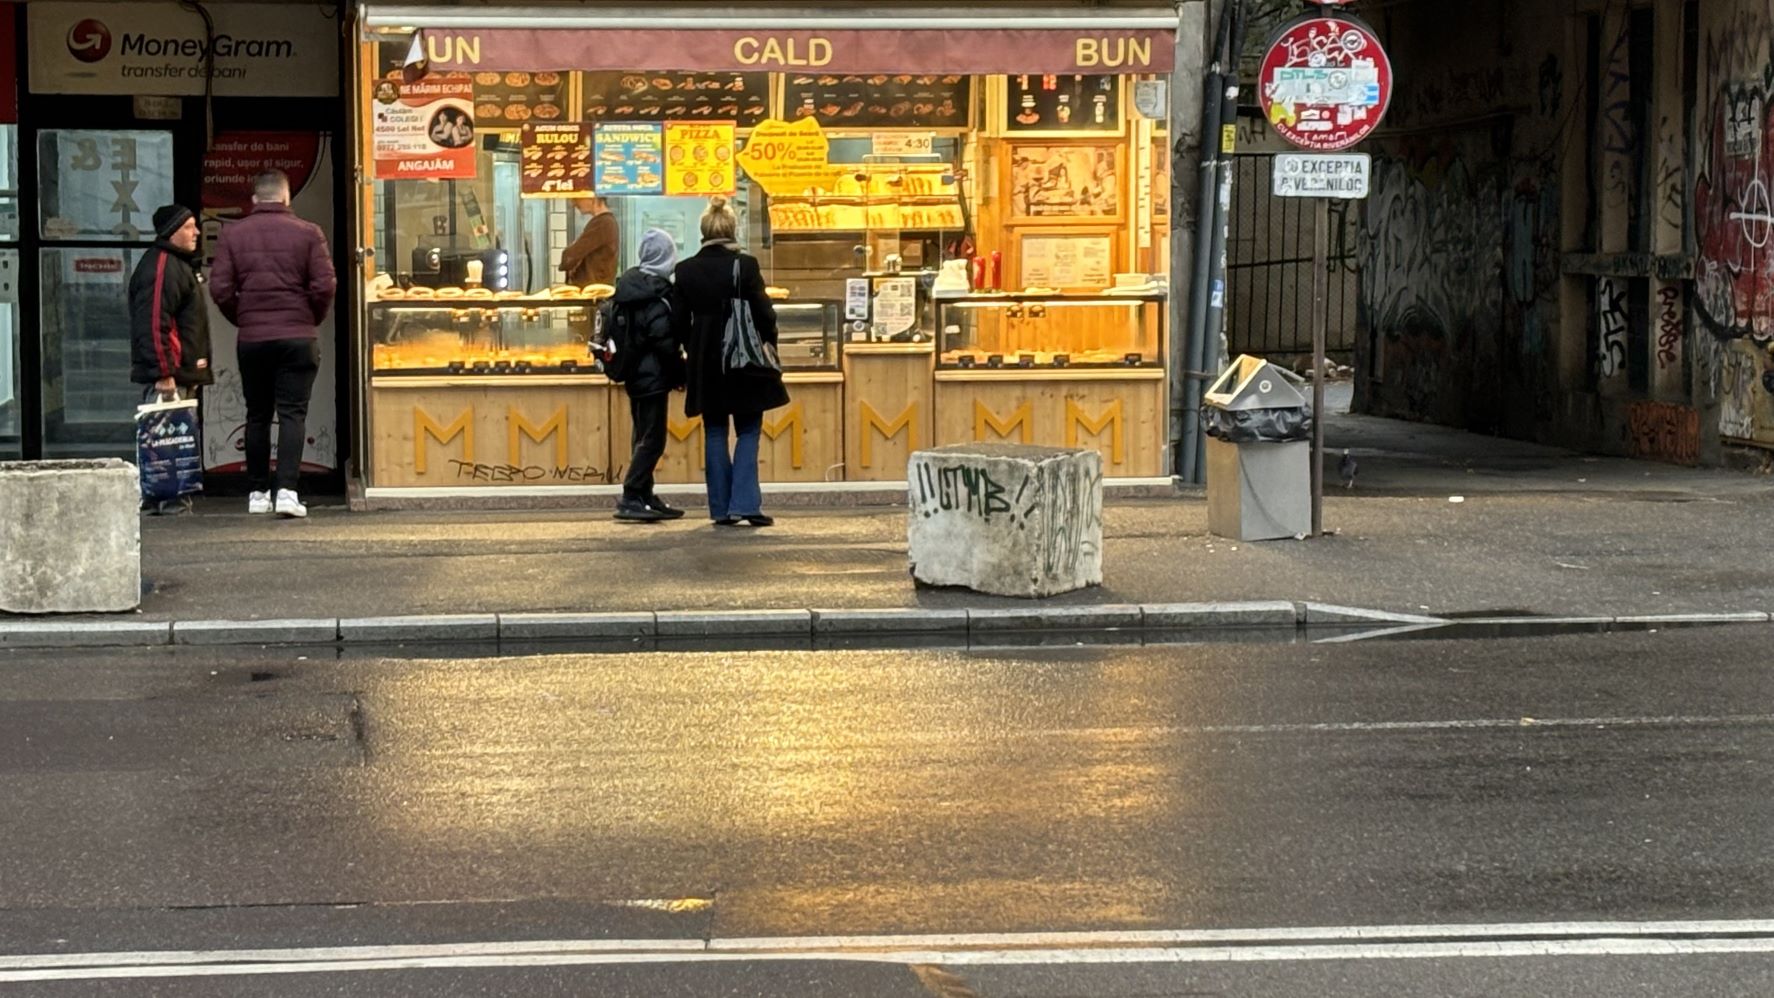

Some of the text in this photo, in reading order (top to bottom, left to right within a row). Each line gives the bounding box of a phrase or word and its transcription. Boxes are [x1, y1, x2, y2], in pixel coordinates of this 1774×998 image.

[120, 33, 293, 63] MoneyGram
[733, 37, 833, 66] CALD
[1075, 37, 1151, 67] BUN
[120, 63, 185, 79] transfer
[536, 133, 579, 144] RULOU
[680, 130, 721, 139] PIZZA
[266, 142, 290, 152] bani
[742, 142, 797, 161] -50%
[397, 158, 455, 172] ANGAJĂM
